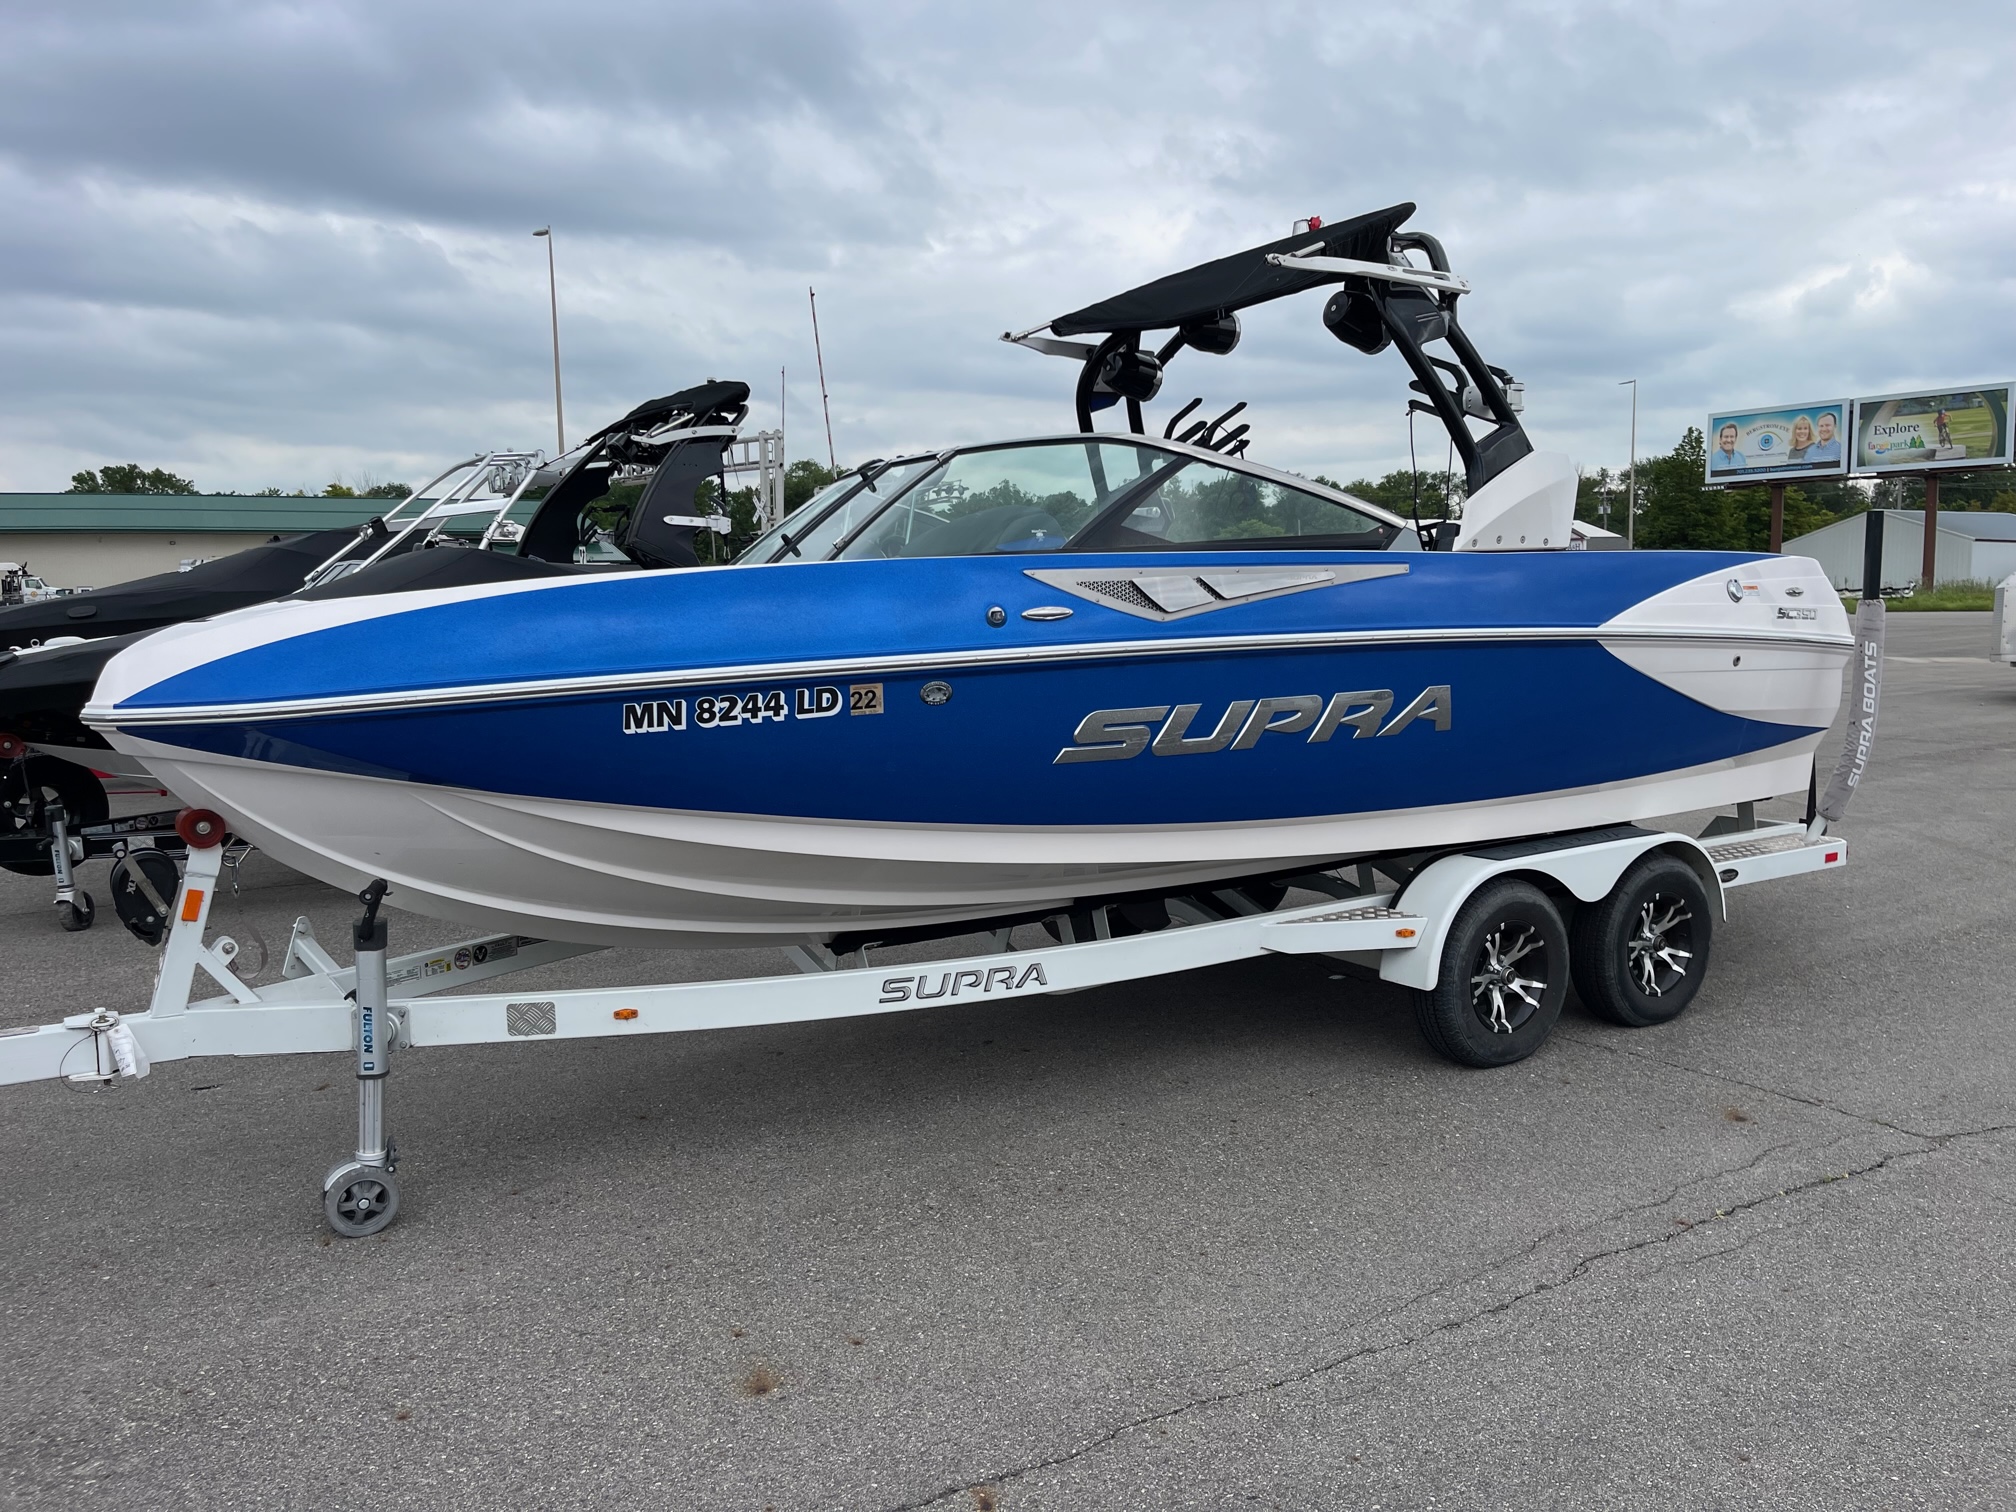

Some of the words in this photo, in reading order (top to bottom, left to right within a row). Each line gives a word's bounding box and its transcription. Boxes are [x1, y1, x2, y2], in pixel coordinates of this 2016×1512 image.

[1873, 422, 1920, 437] Explore
[623, 700, 687, 734] MN
[694, 691, 788, 728] 8244
[795, 686, 843, 719] LD
[850, 690, 877, 711] 22
[1848, 717, 1874, 788] SUPRA
[1862, 641, 1877, 714] BOATS
[1052, 684, 1452, 765] SUPRA
[54, 849, 63, 874] FULTON
[879, 962, 1048, 1003] SUPRA
[362, 1006, 374, 1054] FULTON
